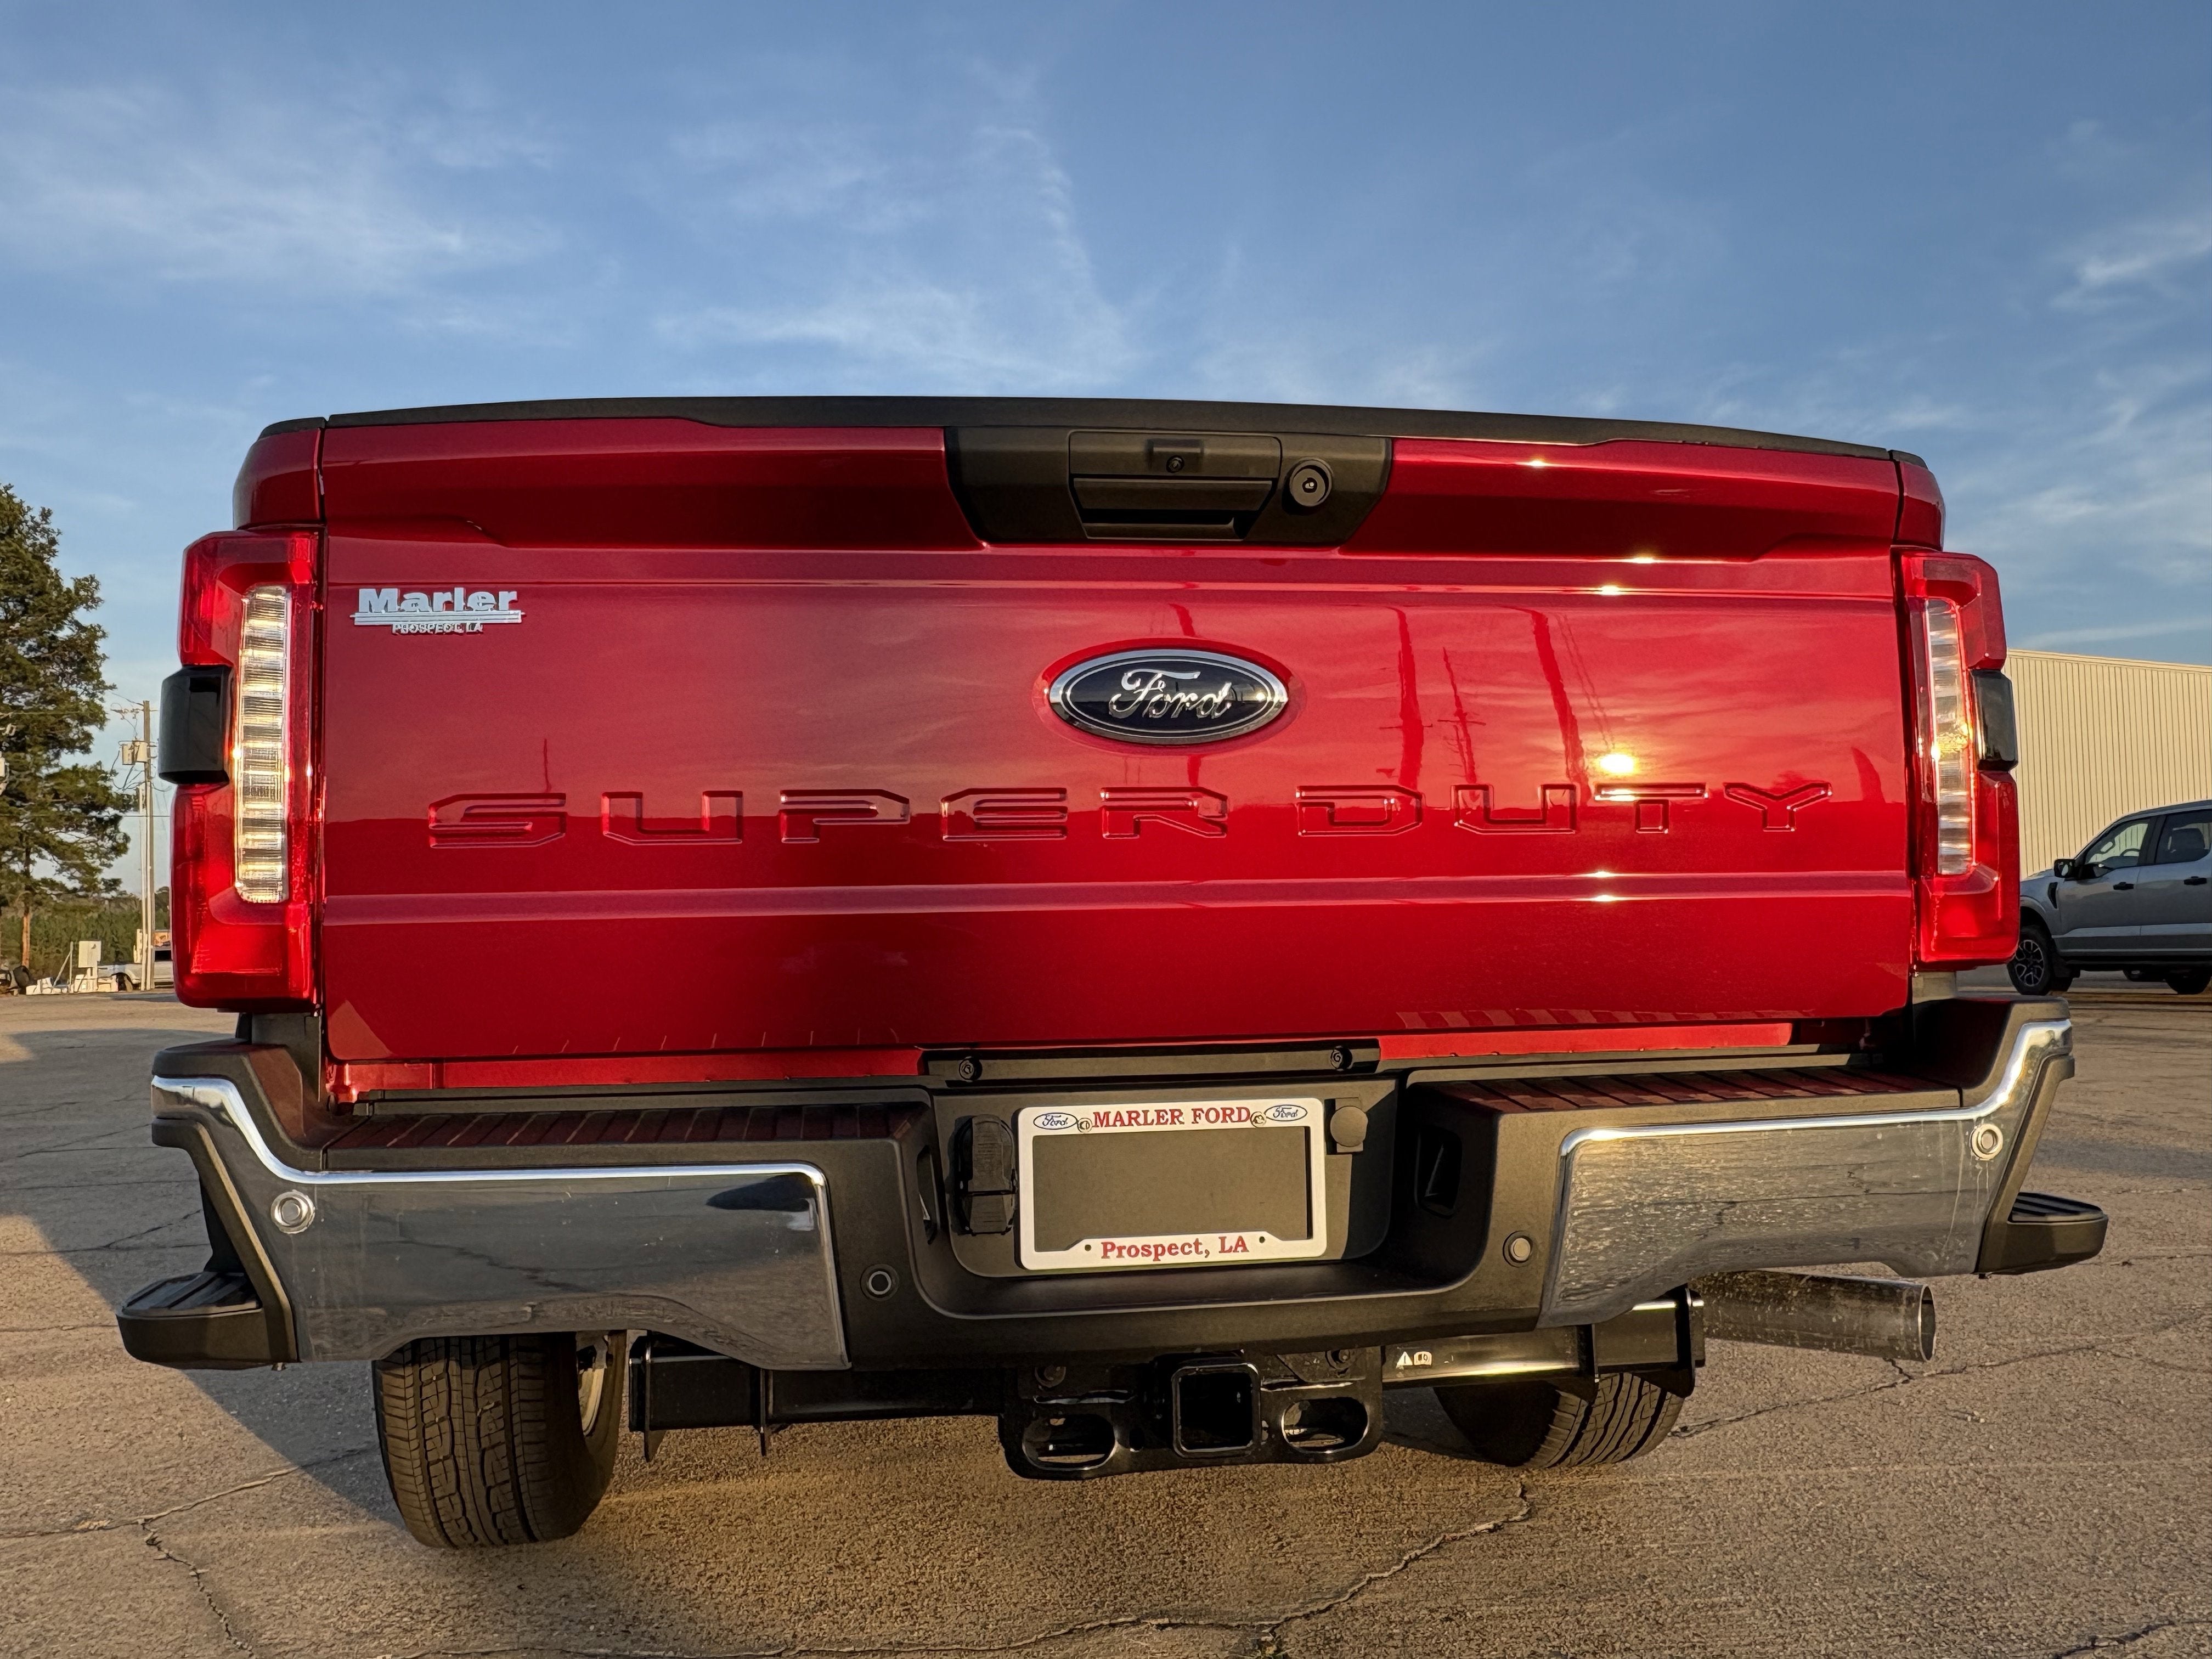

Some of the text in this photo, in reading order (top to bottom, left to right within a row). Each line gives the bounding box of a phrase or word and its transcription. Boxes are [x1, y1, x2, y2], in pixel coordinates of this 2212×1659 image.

[359, 587, 518, 612] Marler
[1108, 668, 1232, 719] Ford
[427, 781, 1833, 848] SUPER DUTY
[1092, 1107, 1251, 1128] MARLER FORD
[1101, 1235, 1250, 1261] Prospect, LA
